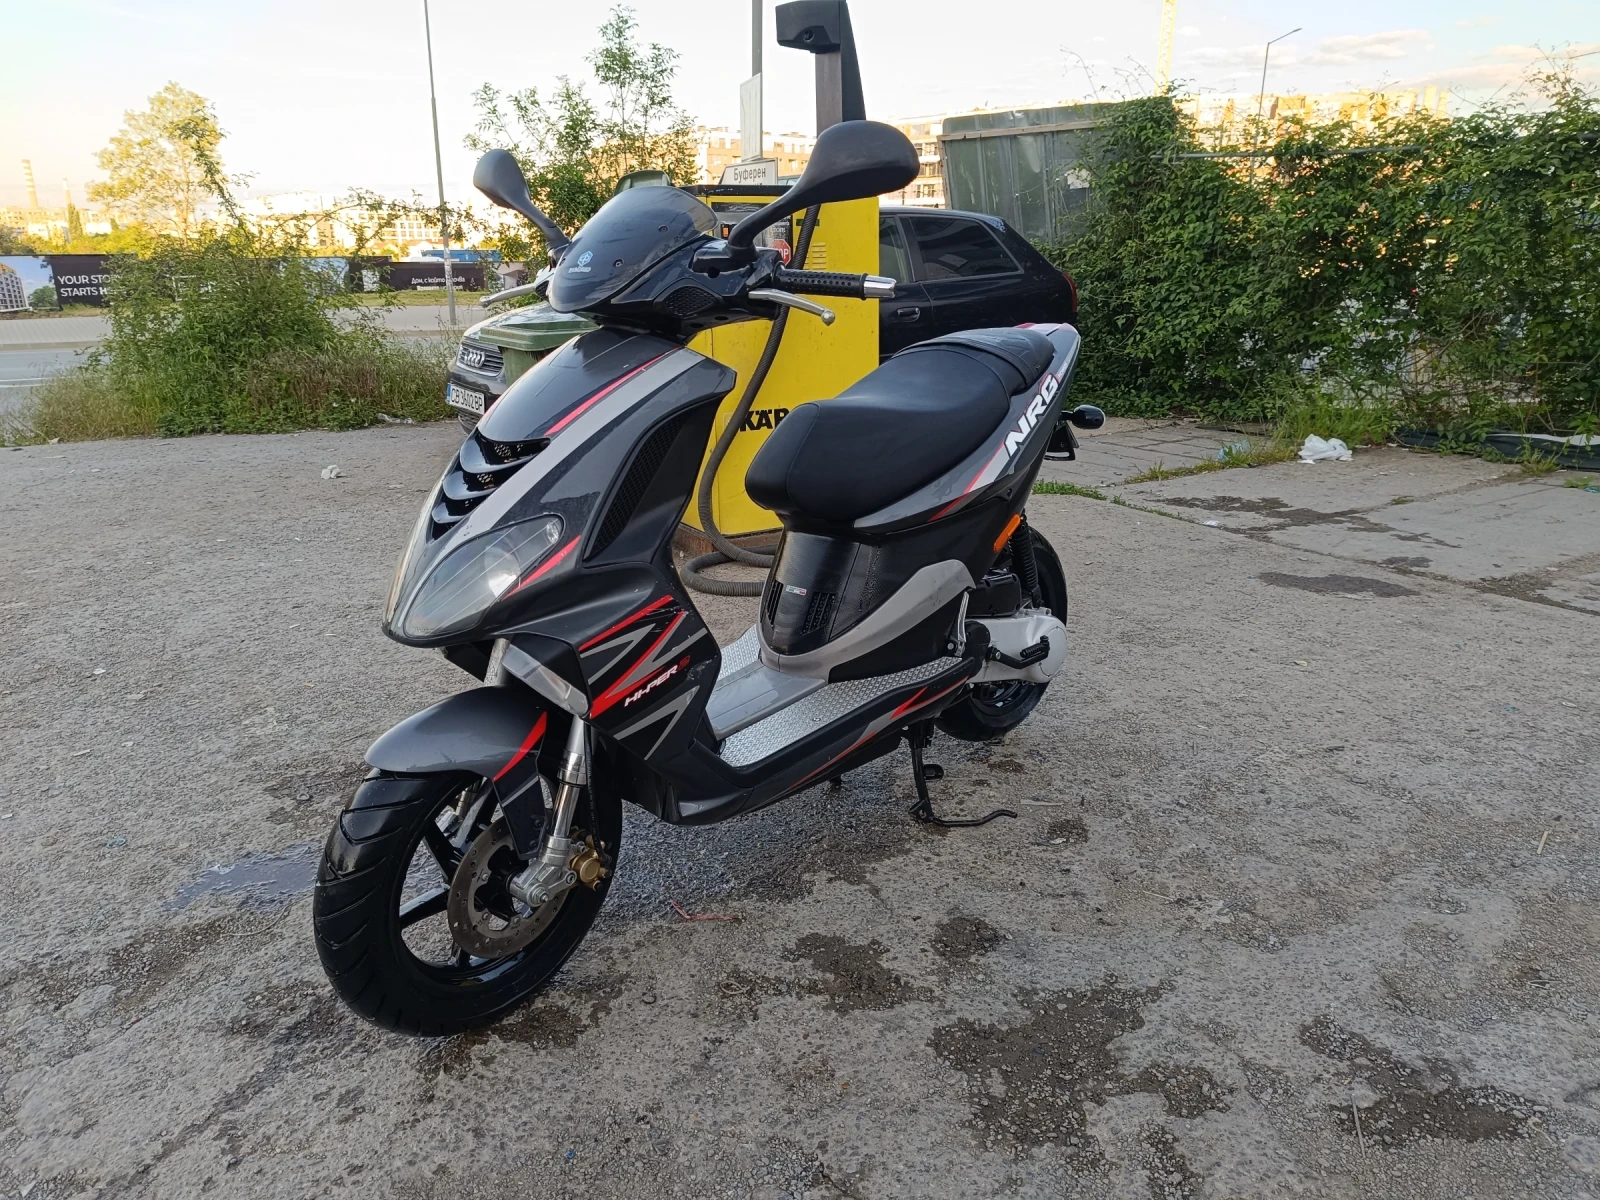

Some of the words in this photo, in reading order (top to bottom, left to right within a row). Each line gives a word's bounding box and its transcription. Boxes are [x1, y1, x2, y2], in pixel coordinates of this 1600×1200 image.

[733, 167, 766, 182] Буферен
[58, 275, 89, 285] YOUR
[60, 287, 98, 297] STARTS
[1005, 374, 1059, 457] NRG
